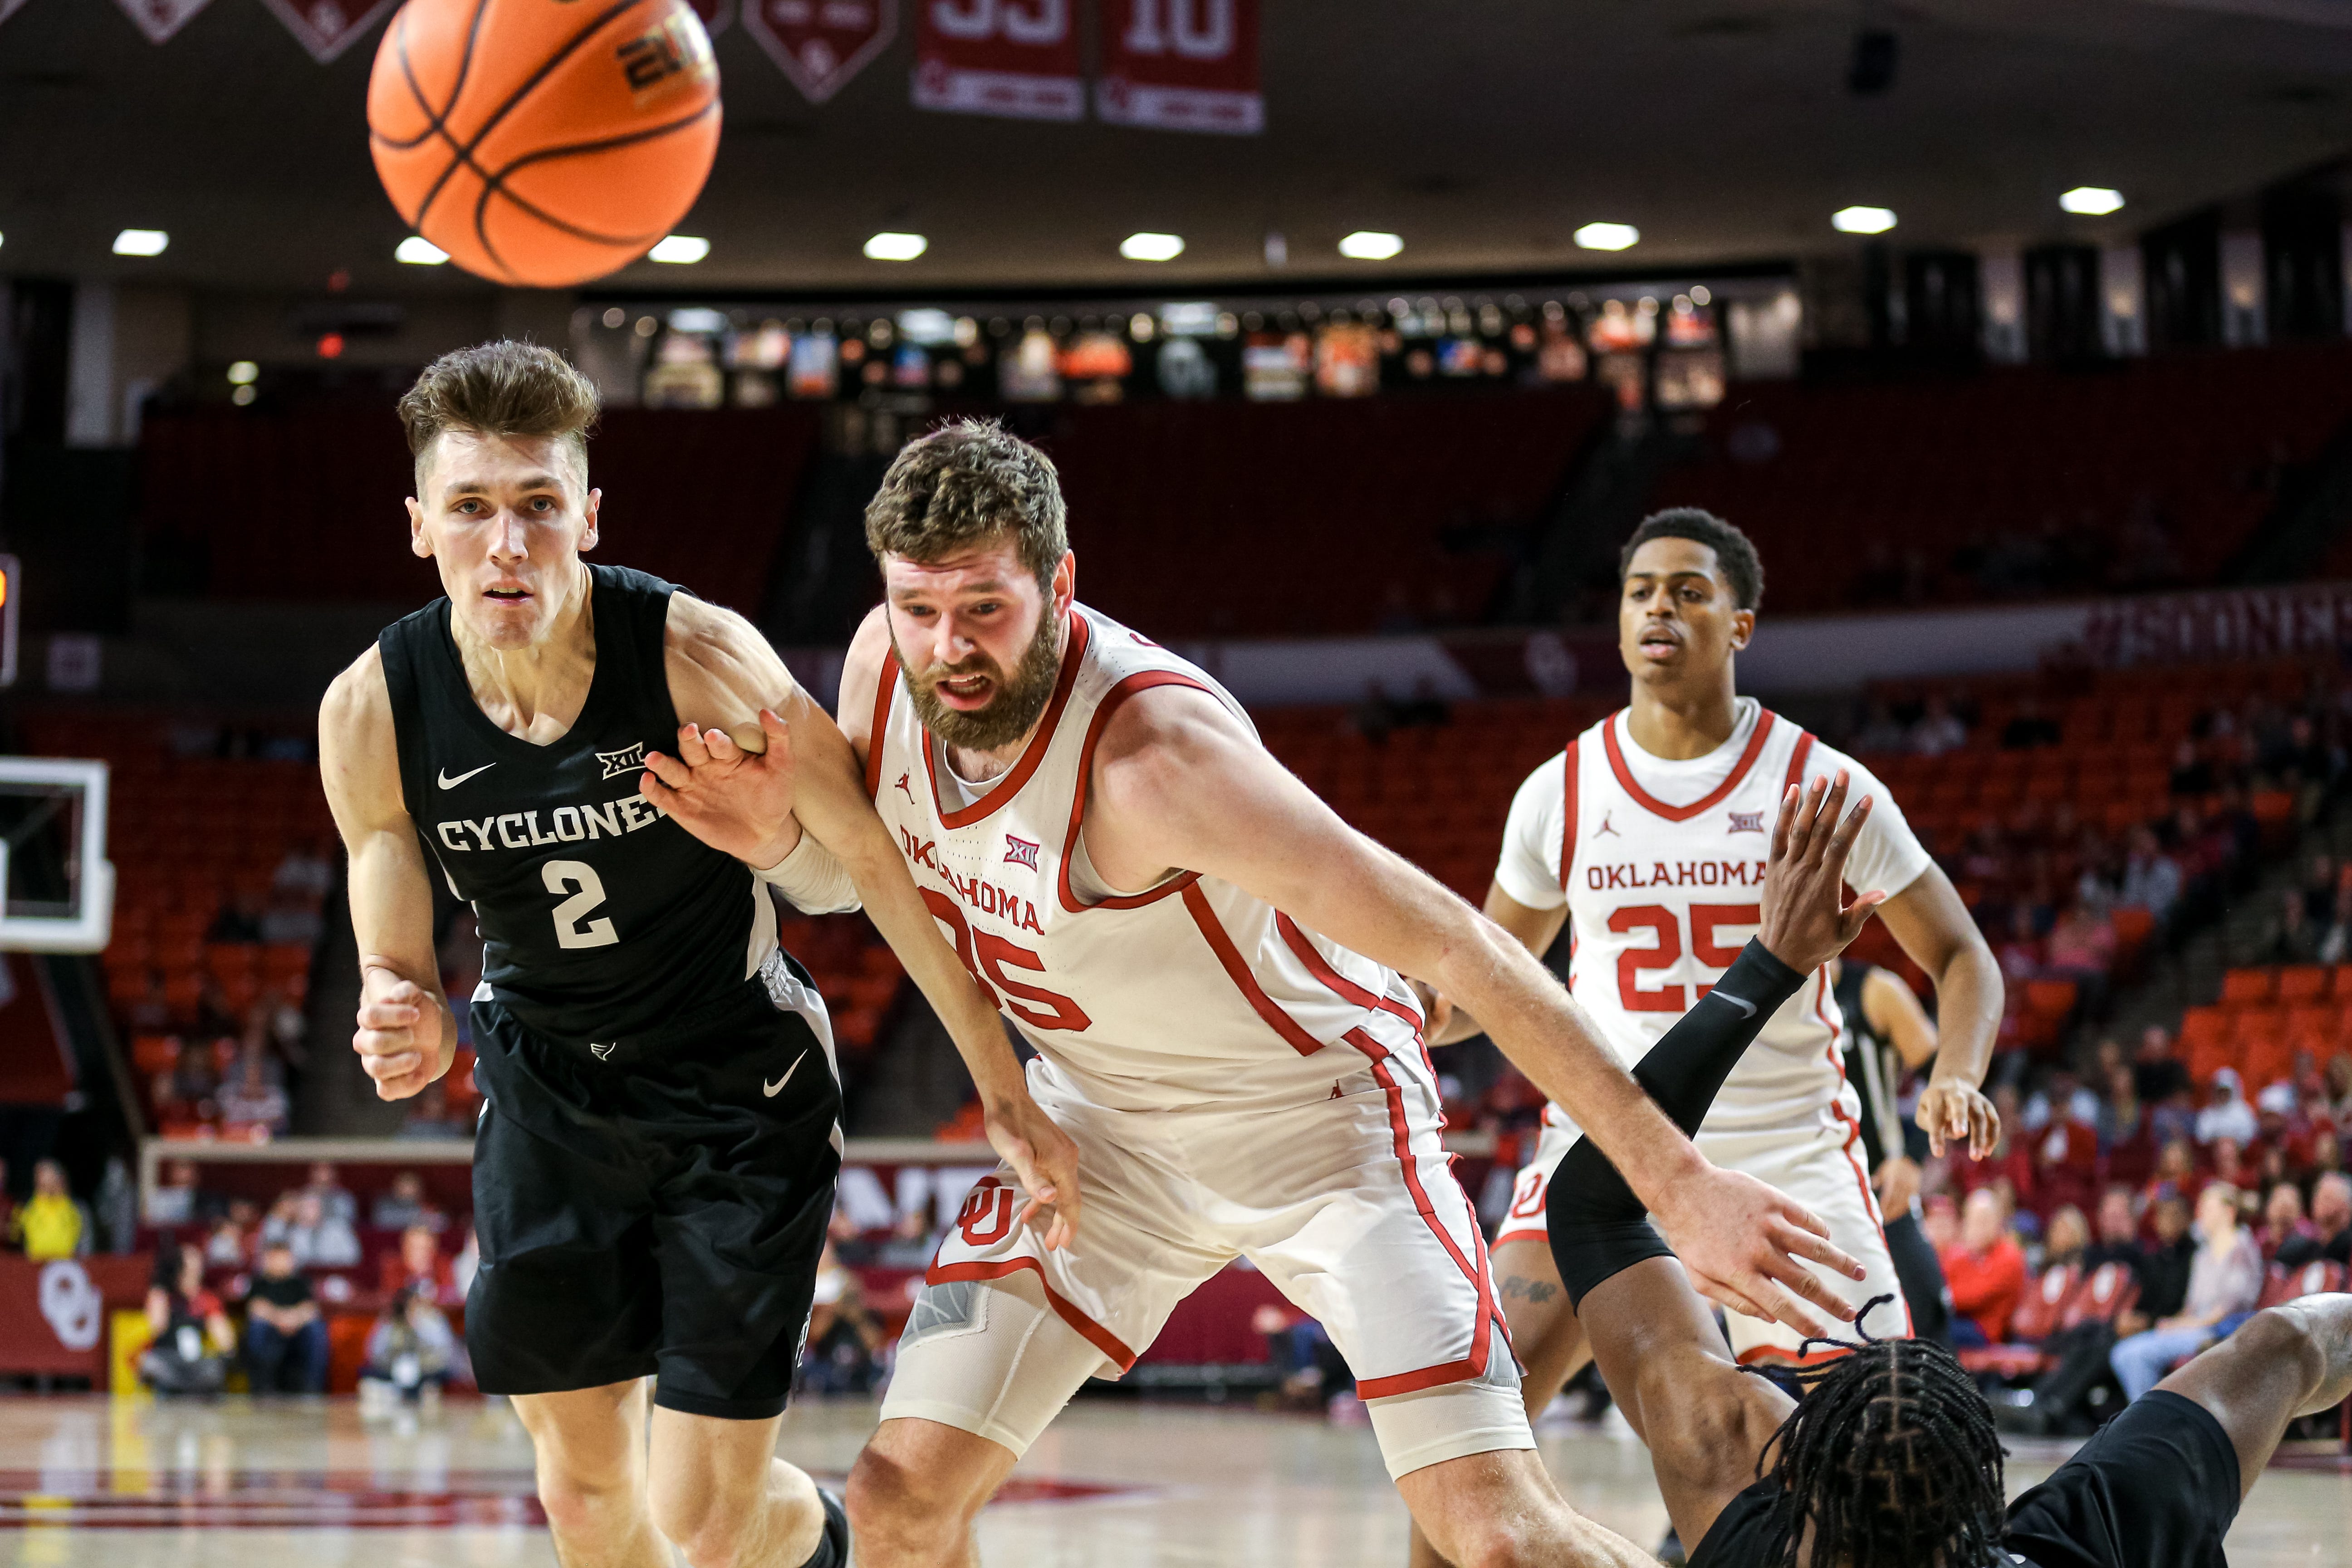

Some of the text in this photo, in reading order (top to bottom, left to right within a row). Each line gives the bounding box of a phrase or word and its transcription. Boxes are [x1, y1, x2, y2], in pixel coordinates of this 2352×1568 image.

[437, 793, 668, 851] CYCLONE
[541, 860, 620, 949] 2
[1588, 860, 1766, 890] OKLAHOMA
[1607, 903, 1762, 1013] 25
